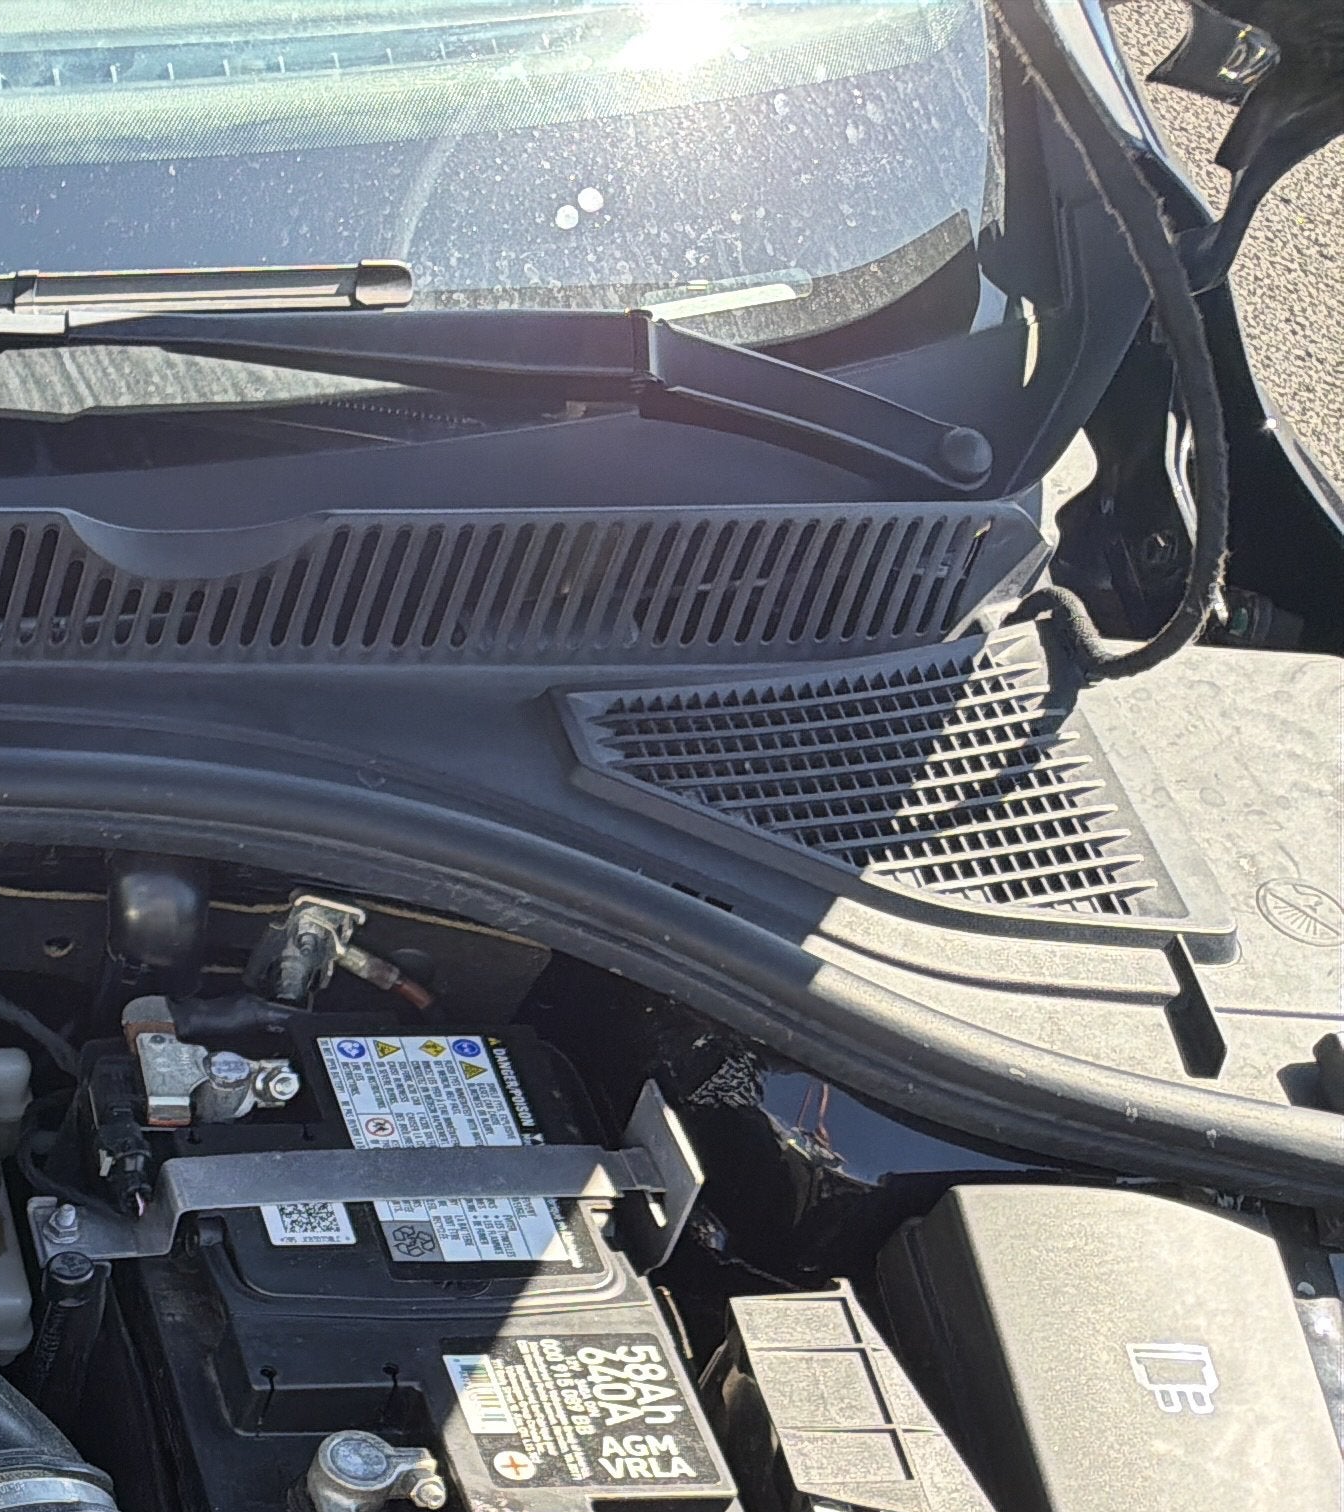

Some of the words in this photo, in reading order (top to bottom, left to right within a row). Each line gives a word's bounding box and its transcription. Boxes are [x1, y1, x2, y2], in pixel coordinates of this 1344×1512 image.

[491, 1046, 535, 1127] DANGER/POISON
[537, 1338, 566, 1361] 000
[576, 1346, 644, 1426] 640A
[618, 1345, 683, 1424] 58Ah
[597, 1456, 696, 1478] VRLA
[602, 1434, 679, 1456] AGM
